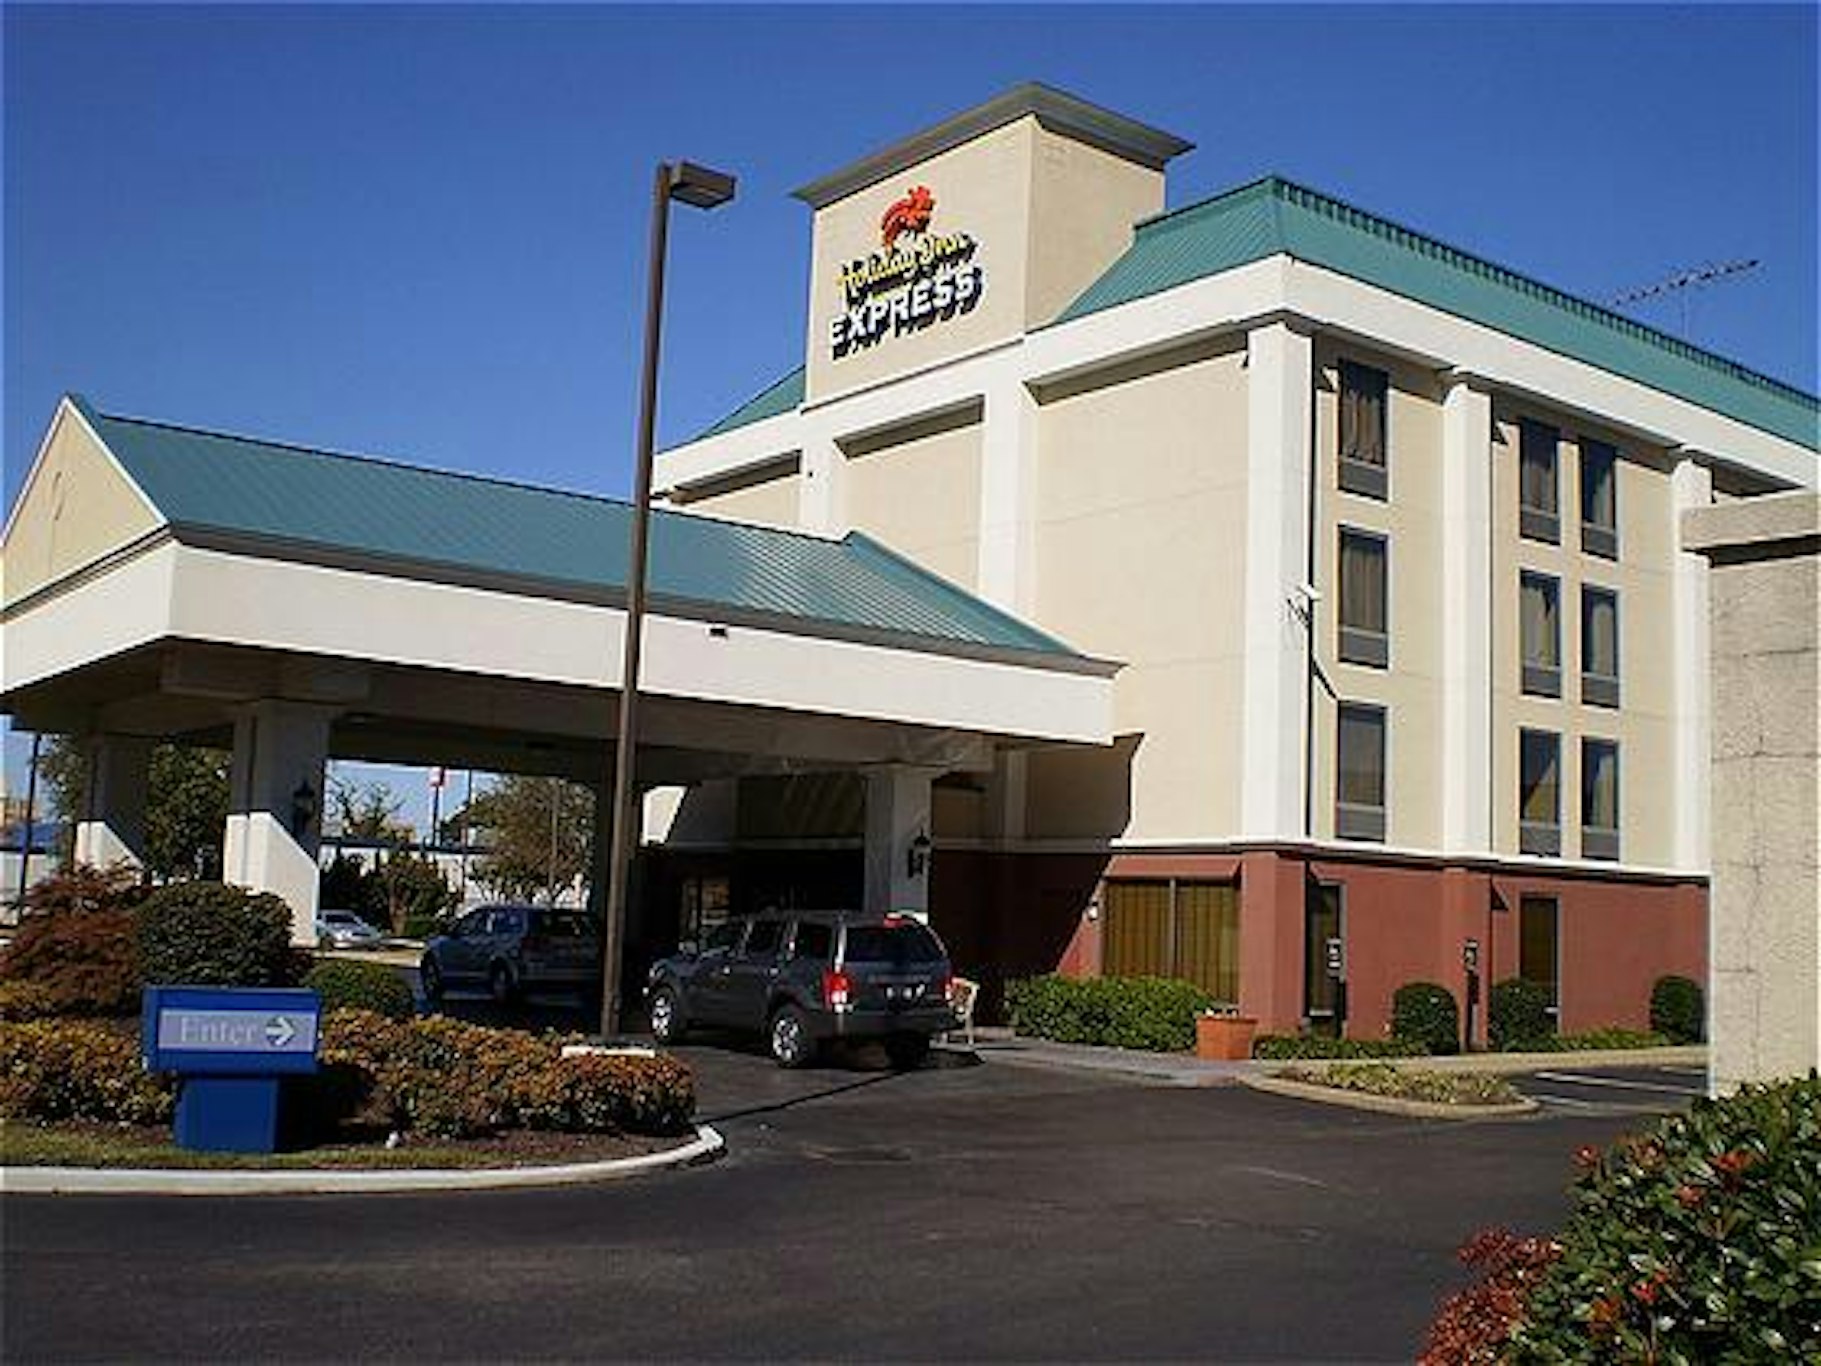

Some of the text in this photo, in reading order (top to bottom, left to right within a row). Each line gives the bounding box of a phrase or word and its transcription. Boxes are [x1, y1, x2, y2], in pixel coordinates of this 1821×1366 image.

[837, 232, 970, 287] Holiday Inn
[831, 268, 978, 347] EXPRESS
[180, 1015, 259, 1044] Enter
